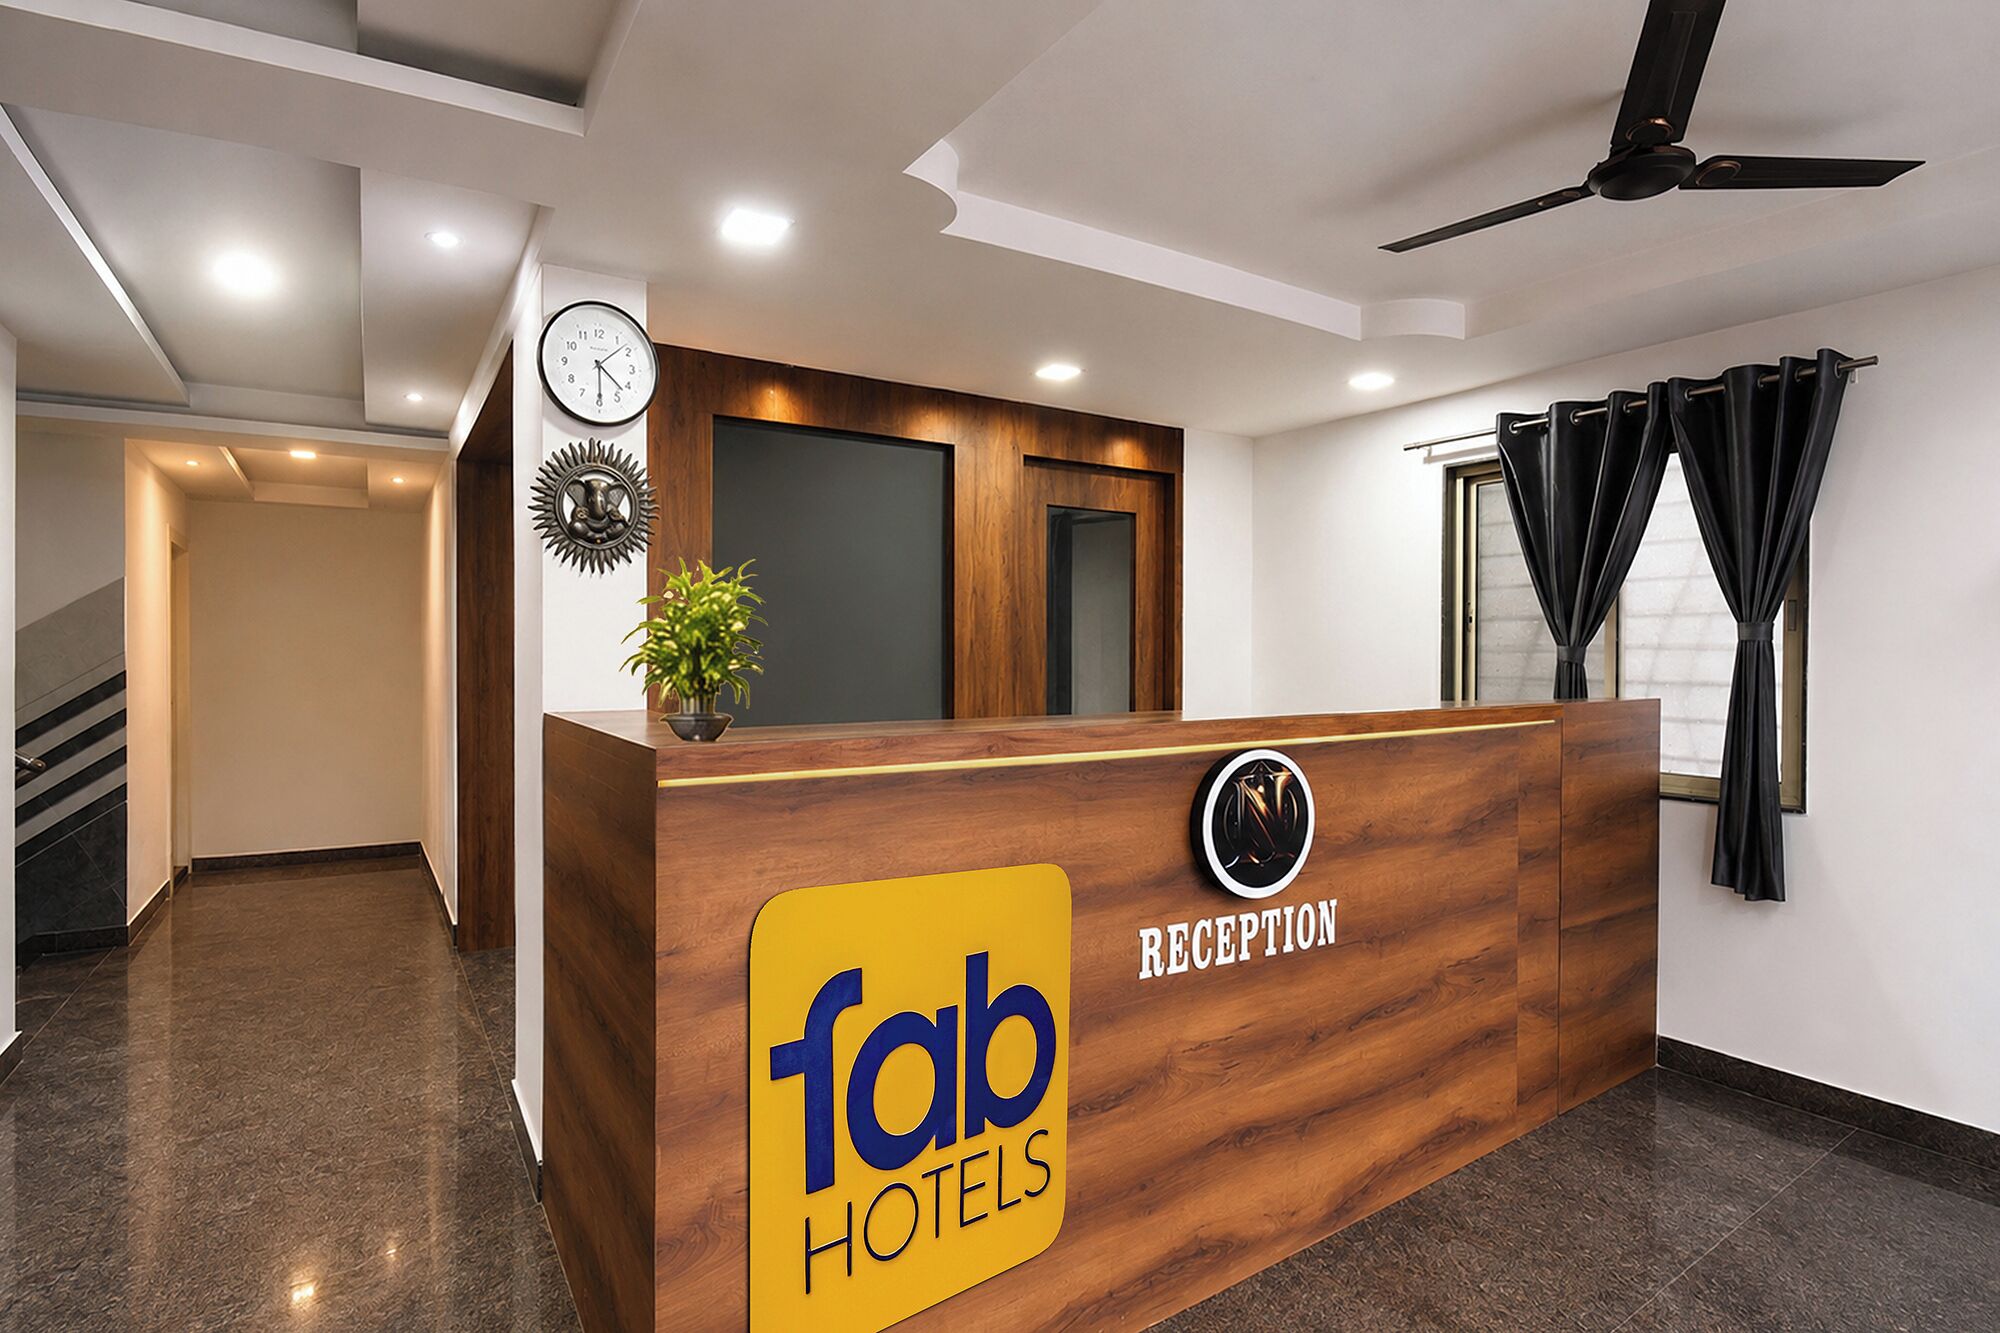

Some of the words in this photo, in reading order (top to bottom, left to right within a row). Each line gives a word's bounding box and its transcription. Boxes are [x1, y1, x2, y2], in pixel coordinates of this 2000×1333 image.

[578, 330, 588, 340] 11
[594, 329, 605, 339] 12
[615, 335, 620, 345] 1
[566, 341, 577, 351] 10
[625, 347, 632, 357] 2
[561, 356, 568, 366] 9
[629, 364, 636, 375] 3
[568, 373, 575, 383] 8
[624, 381, 631, 390] 4
[579, 388, 586, 397] 7
[614, 391, 621, 403] 5
[1138, 898, 1338, 980] RECEPTION
[769, 950, 1057, 1195] fab
[804, 1128, 1051, 1295] HOTELS
